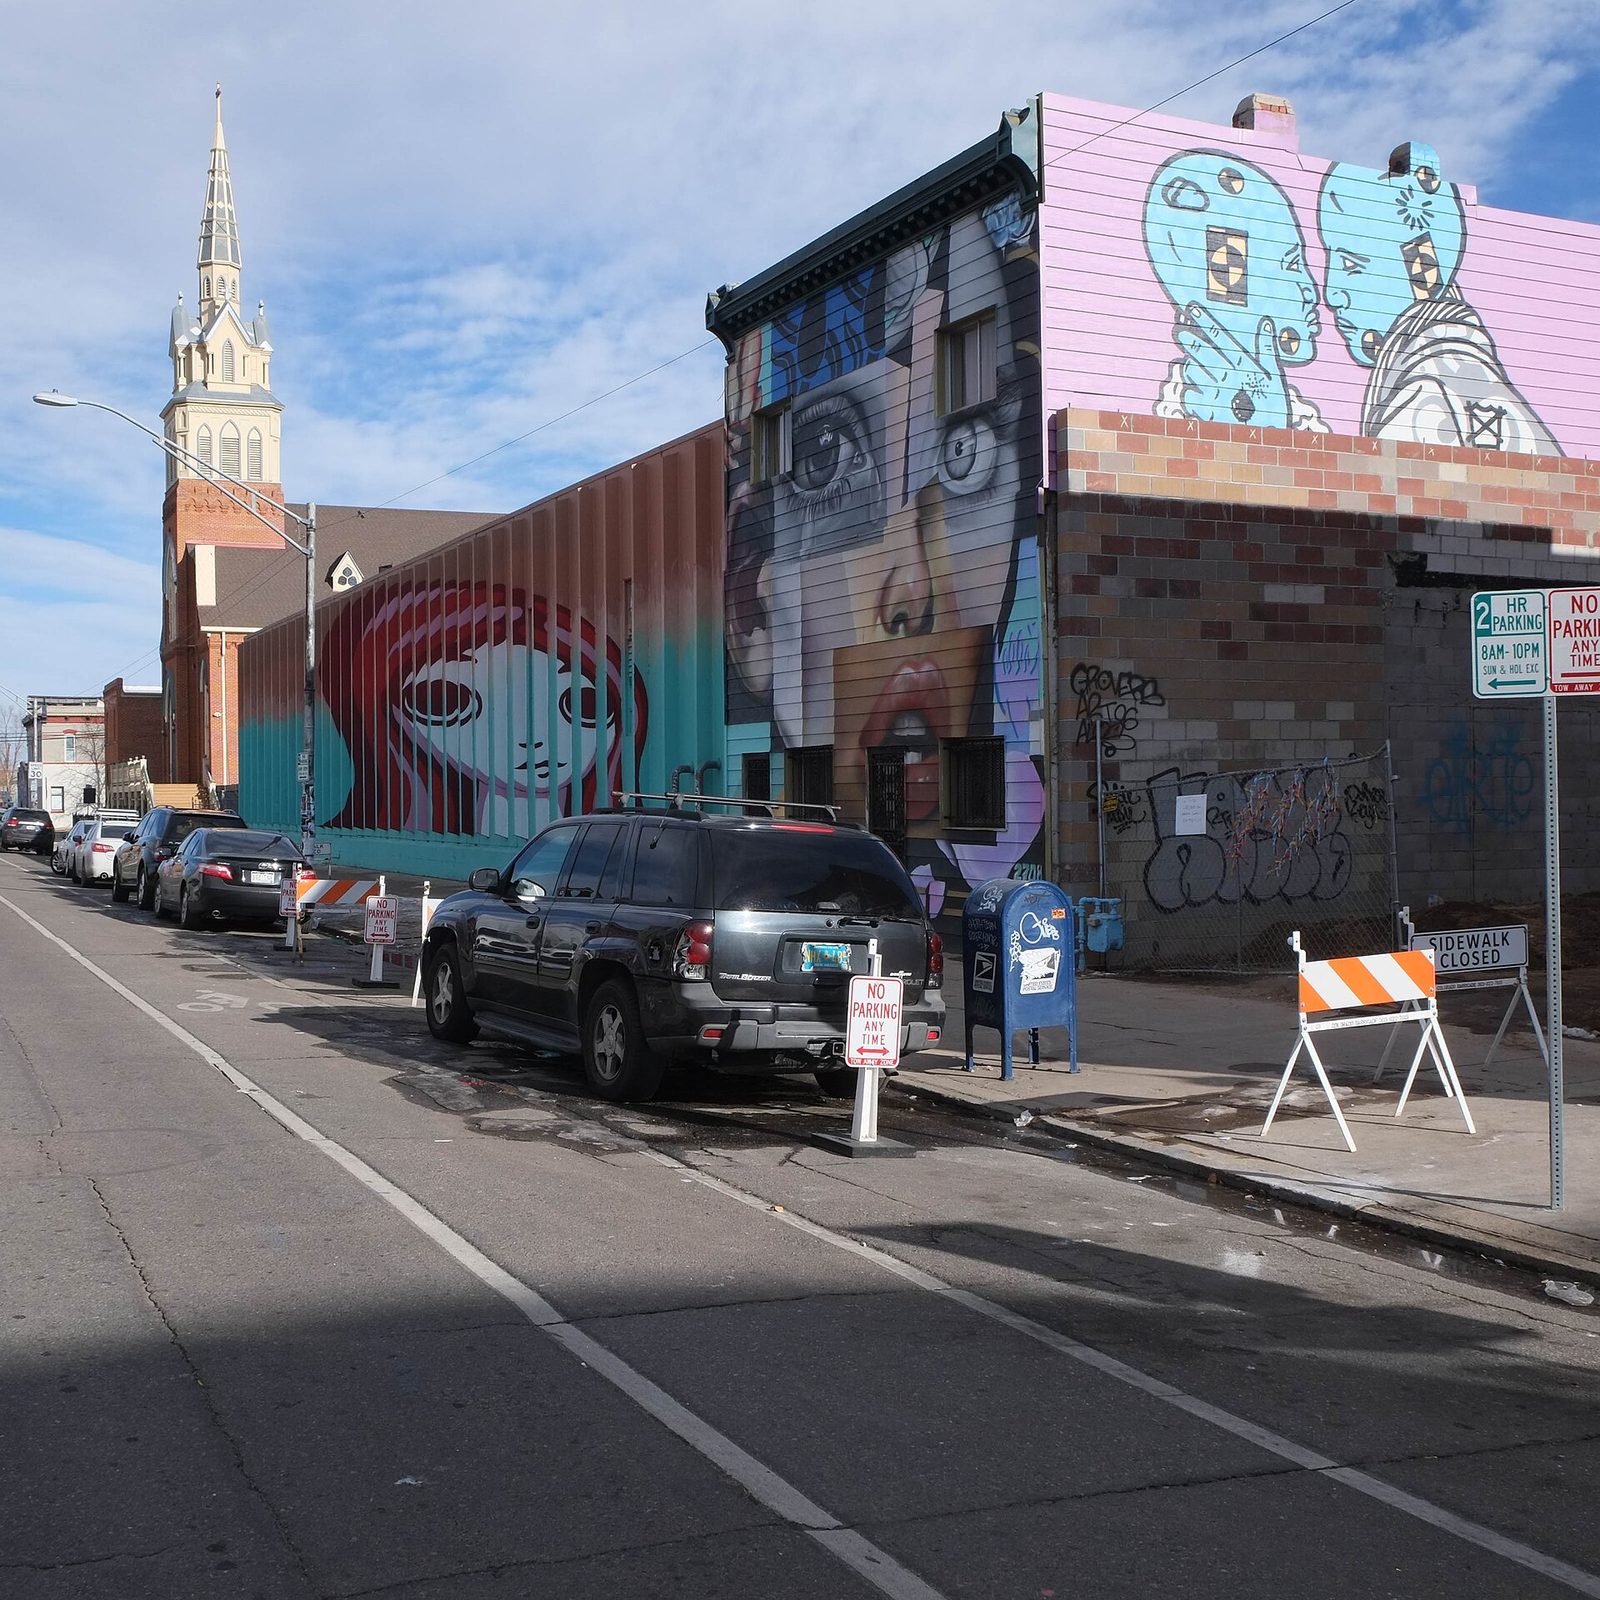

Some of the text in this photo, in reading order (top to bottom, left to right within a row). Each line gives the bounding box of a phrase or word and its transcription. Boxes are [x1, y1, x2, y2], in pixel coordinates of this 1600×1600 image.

[1507, 597, 1527, 613] HR
[1571, 595, 1598, 614] NO
[1476, 602, 1489, 629] 2
[1493, 614, 1542, 631] PARKING
[1553, 619, 1600, 638] PARKI
[1572, 640, 1599, 653] ANY
[1570, 653, 1600, 667] TIME
[1483, 665, 1496, 675] SUN
[1509, 664, 1522, 674] HOL
[1526, 663, 1539, 673] EXC
[1554, 684, 1569, 692] TOW
[1574, 683, 1594, 691] AWAY
[30, 770, 42, 778] 30
[376, 900, 388, 909] NO
[368, 909, 395, 919] PARKING
[1429, 931, 1510, 951] SIDEWALK
[1440, 949, 1500, 968] CLOSED
[867, 983, 885, 999] NO
[852, 1001, 897, 1019] PARKING
[864, 1021, 884, 1031] ANY
[862, 1033, 885, 1045] TIME
